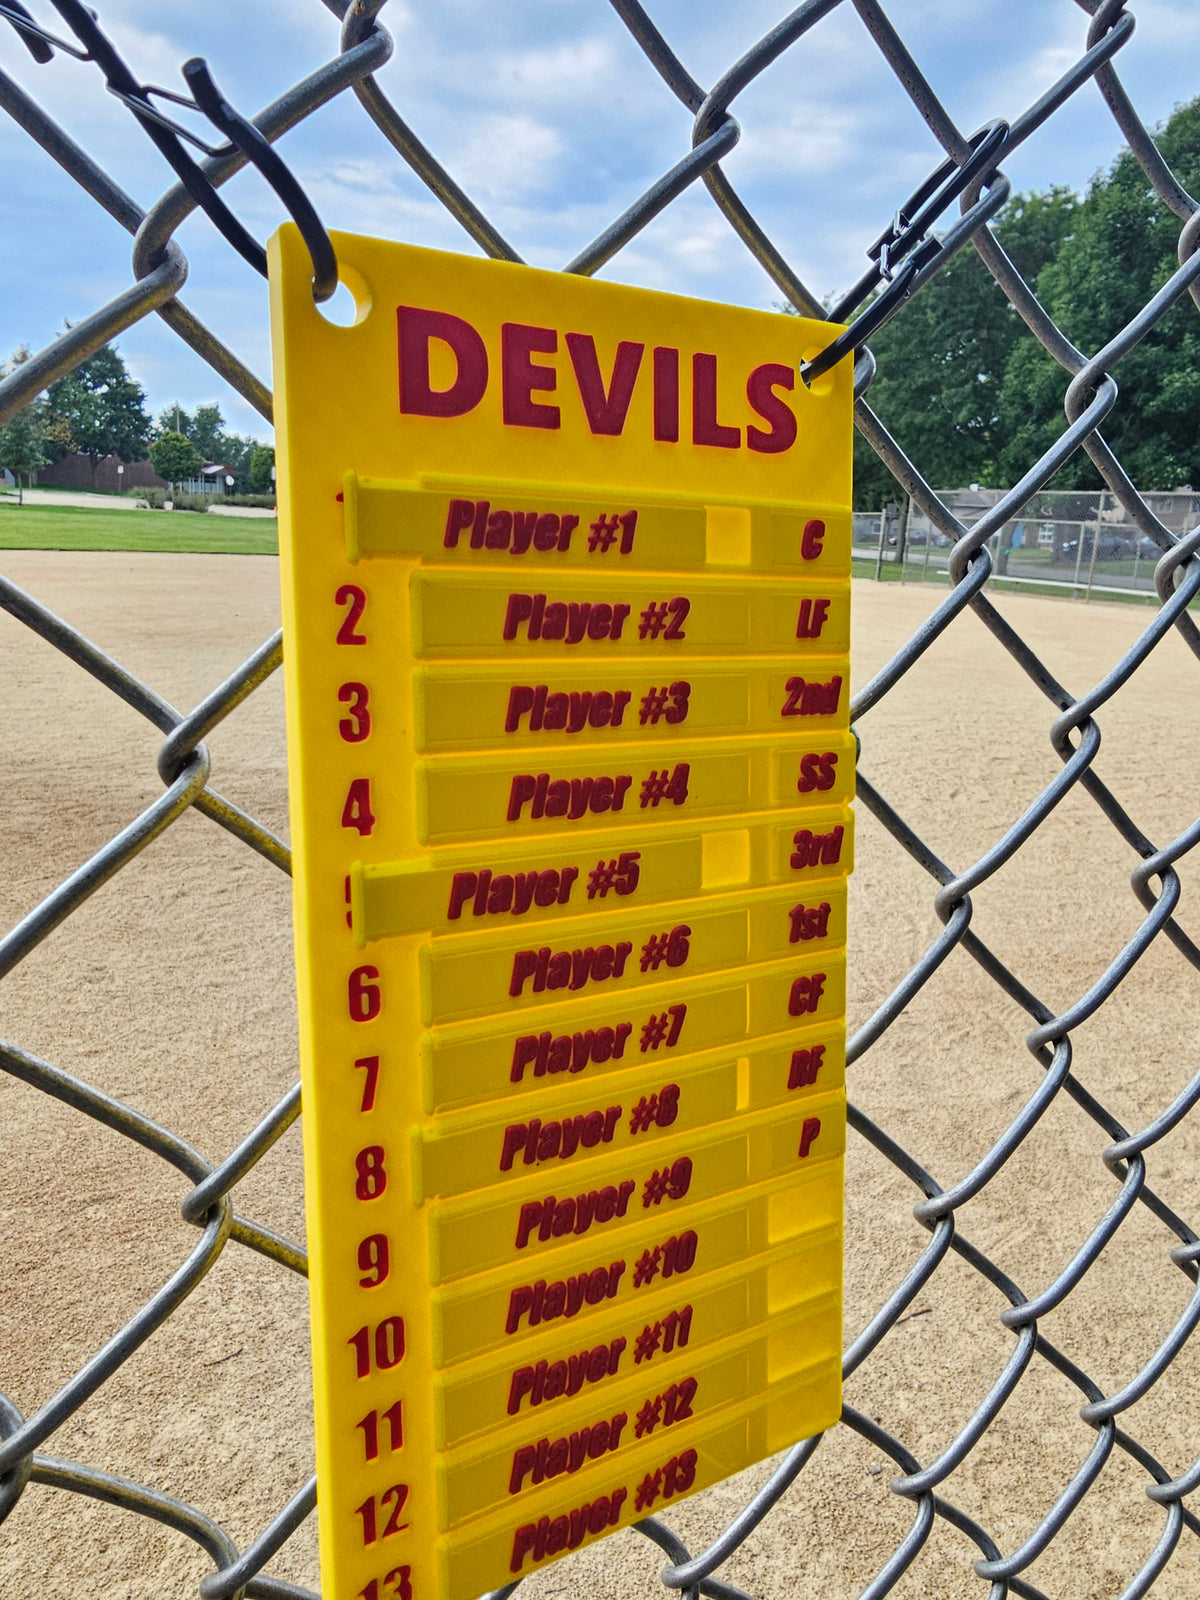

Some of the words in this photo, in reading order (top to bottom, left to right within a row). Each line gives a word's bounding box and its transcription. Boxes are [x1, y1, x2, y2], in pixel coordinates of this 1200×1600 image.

[396, 305, 798, 454] DEVILS
[444, 499, 579, 555] Player
[588, 510, 637, 555] #1
[801, 520, 825, 560] C
[335, 585, 366, 645] 2
[503, 594, 631, 644] Player
[639, 597, 690, 640] #2
[796, 599, 830, 638] LF
[338, 682, 370, 742] 3
[505, 685, 631, 739] Player
[639, 681, 691, 725] #3
[781, 676, 842, 716] 2nd
[507, 774, 632, 821] Player
[640, 763, 690, 808] #4
[798, 752, 838, 793] SS
[342, 779, 375, 836] 4
[790, 826, 844, 869] 3rd
[447, 867, 579, 920] Player
[587, 852, 641, 899] #5
[789, 903, 831, 943] 1st
[509, 942, 632, 997] Player
[640, 925, 691, 972] #6
[348, 965, 380, 1022] 6
[788, 973, 826, 1016] CF
[510, 1023, 632, 1083] Player
[640, 1004, 687, 1052] #7
[787, 1045, 826, 1090] RF
[355, 1056, 379, 1112] 7
[500, 1105, 622, 1171] Player
[629, 1084, 680, 1135] #8
[798, 1118, 821, 1158] P
[356, 1146, 386, 1201] 8
[515, 1179, 635, 1249] Player
[642, 1157, 693, 1208] #9
[358, 1234, 389, 1288] 9
[505, 1260, 626, 1335] Player
[633, 1230, 698, 1288] #10
[347, 1316, 405, 1378] 10
[507, 1337, 627, 1416] Player
[634, 1305, 693, 1364] #11
[356, 1400, 402, 1461] 11
[509, 1412, 628, 1495] Player
[635, 1377, 698, 1439] #12
[355, 1484, 409, 1545] 12
[510, 1487, 628, 1573] Player
[634, 1449, 698, 1512] #13
